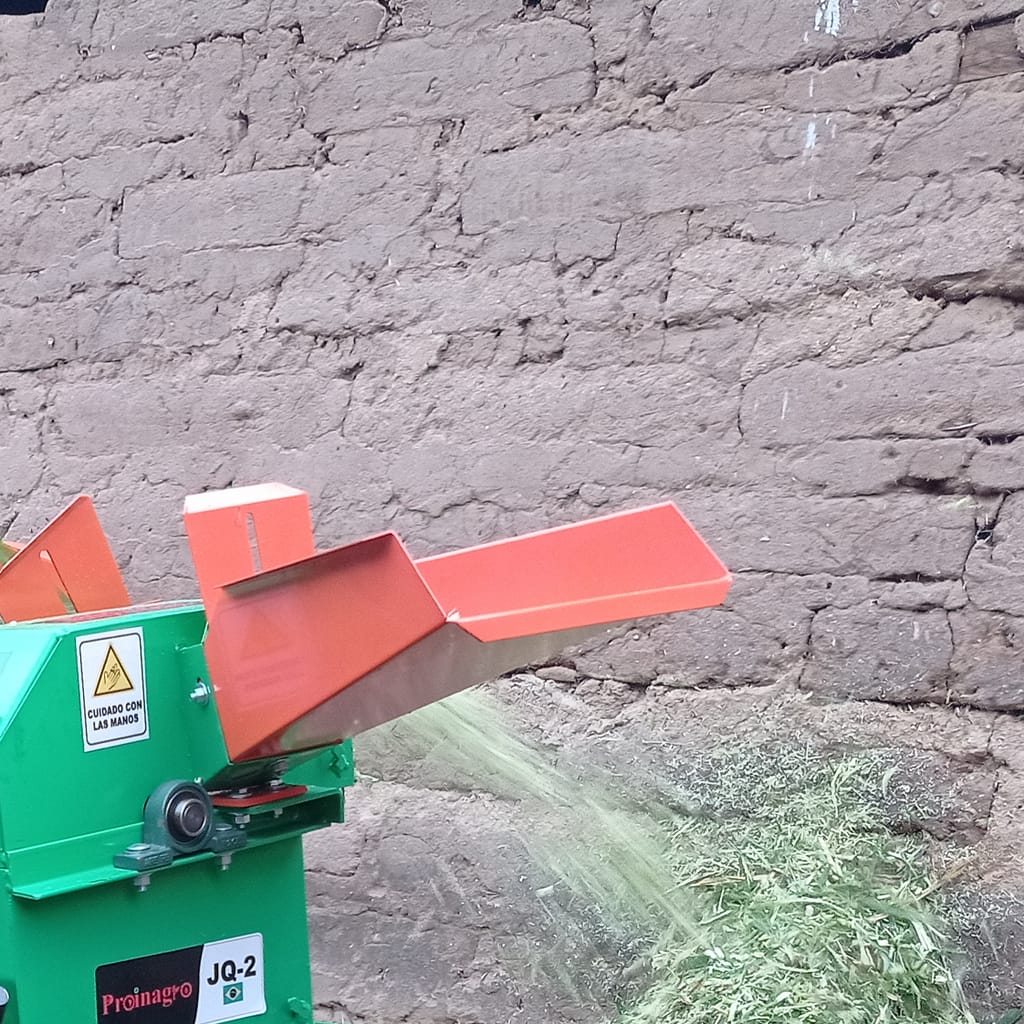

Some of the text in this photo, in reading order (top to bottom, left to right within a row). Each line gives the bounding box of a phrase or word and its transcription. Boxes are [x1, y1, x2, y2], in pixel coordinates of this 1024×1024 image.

[87, 699, 143, 719] CUIDADO CON
[93, 713, 139, 731] LAS MANOS
[207, 955, 257, 985] JQ-2
[102, 982, 193, 1016] Proinagro
